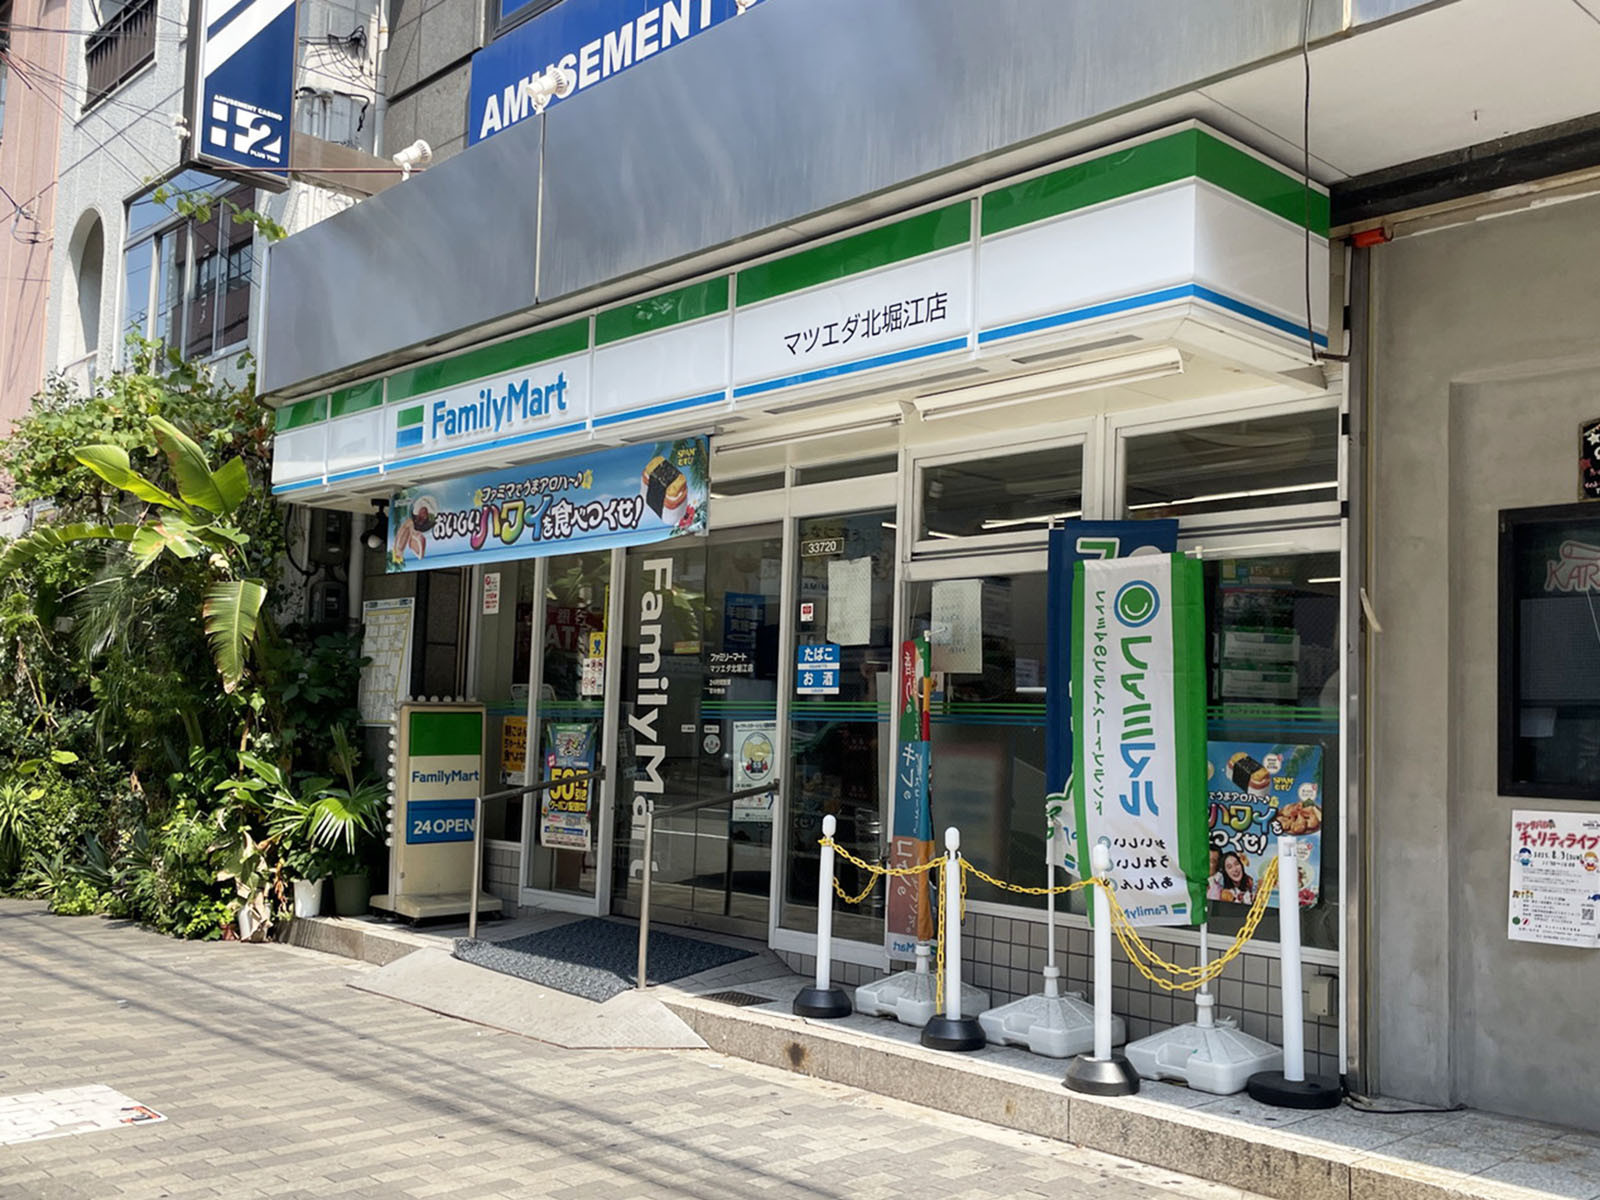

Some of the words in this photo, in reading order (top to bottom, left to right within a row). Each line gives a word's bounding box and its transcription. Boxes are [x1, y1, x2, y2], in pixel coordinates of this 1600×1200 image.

[784, 292, 948, 355] マツエダ北堀江店
[432, 371, 567, 440] FamilyMart
[808, 541, 837, 553] 33720
[710, 652, 747, 662] ファミリーマート
[804, 647, 834, 662] たばこ
[411, 769, 479, 784] FamilyMart
[413, 820, 431, 835] 24
[433, 818, 475, 834] OPEN
[1519, 831, 1600, 850] チャリティライブ
